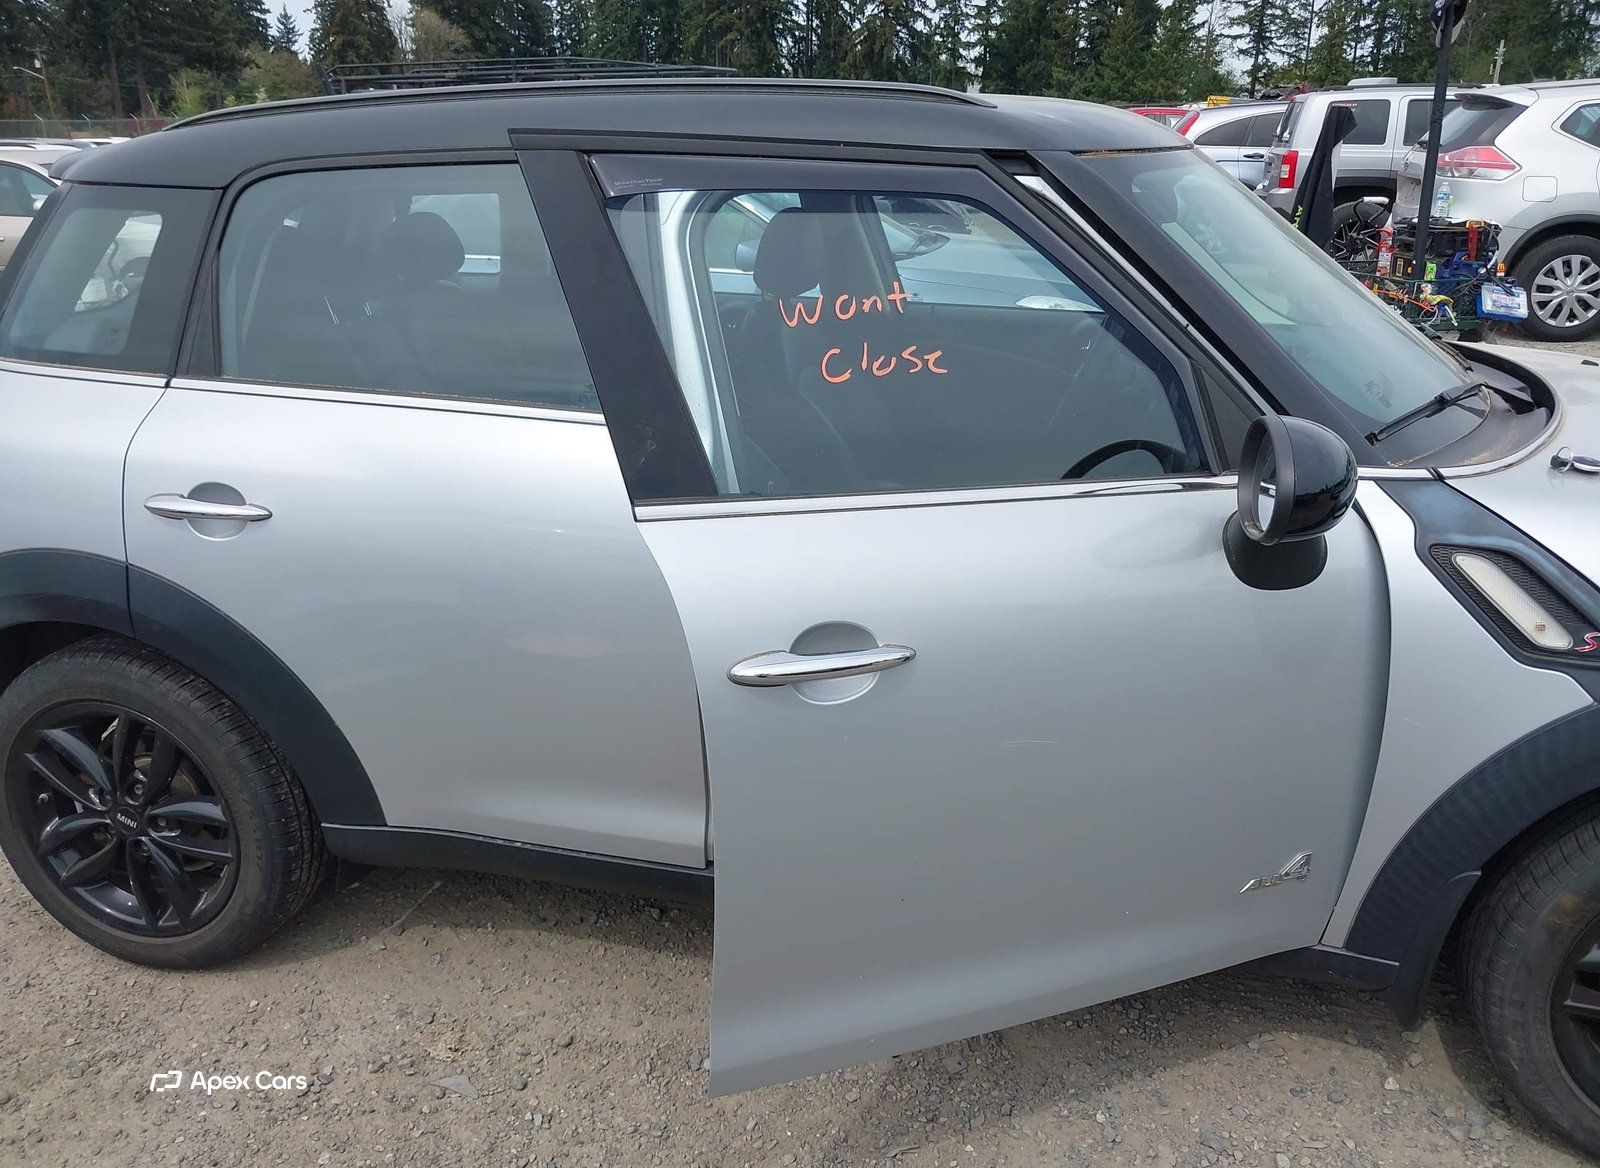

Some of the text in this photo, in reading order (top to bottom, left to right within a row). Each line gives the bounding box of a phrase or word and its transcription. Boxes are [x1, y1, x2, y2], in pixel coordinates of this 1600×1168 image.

[779, 281, 914, 328] Wont
[1573, 631, 1600, 653] S
[116, 812, 138, 829] MINI
